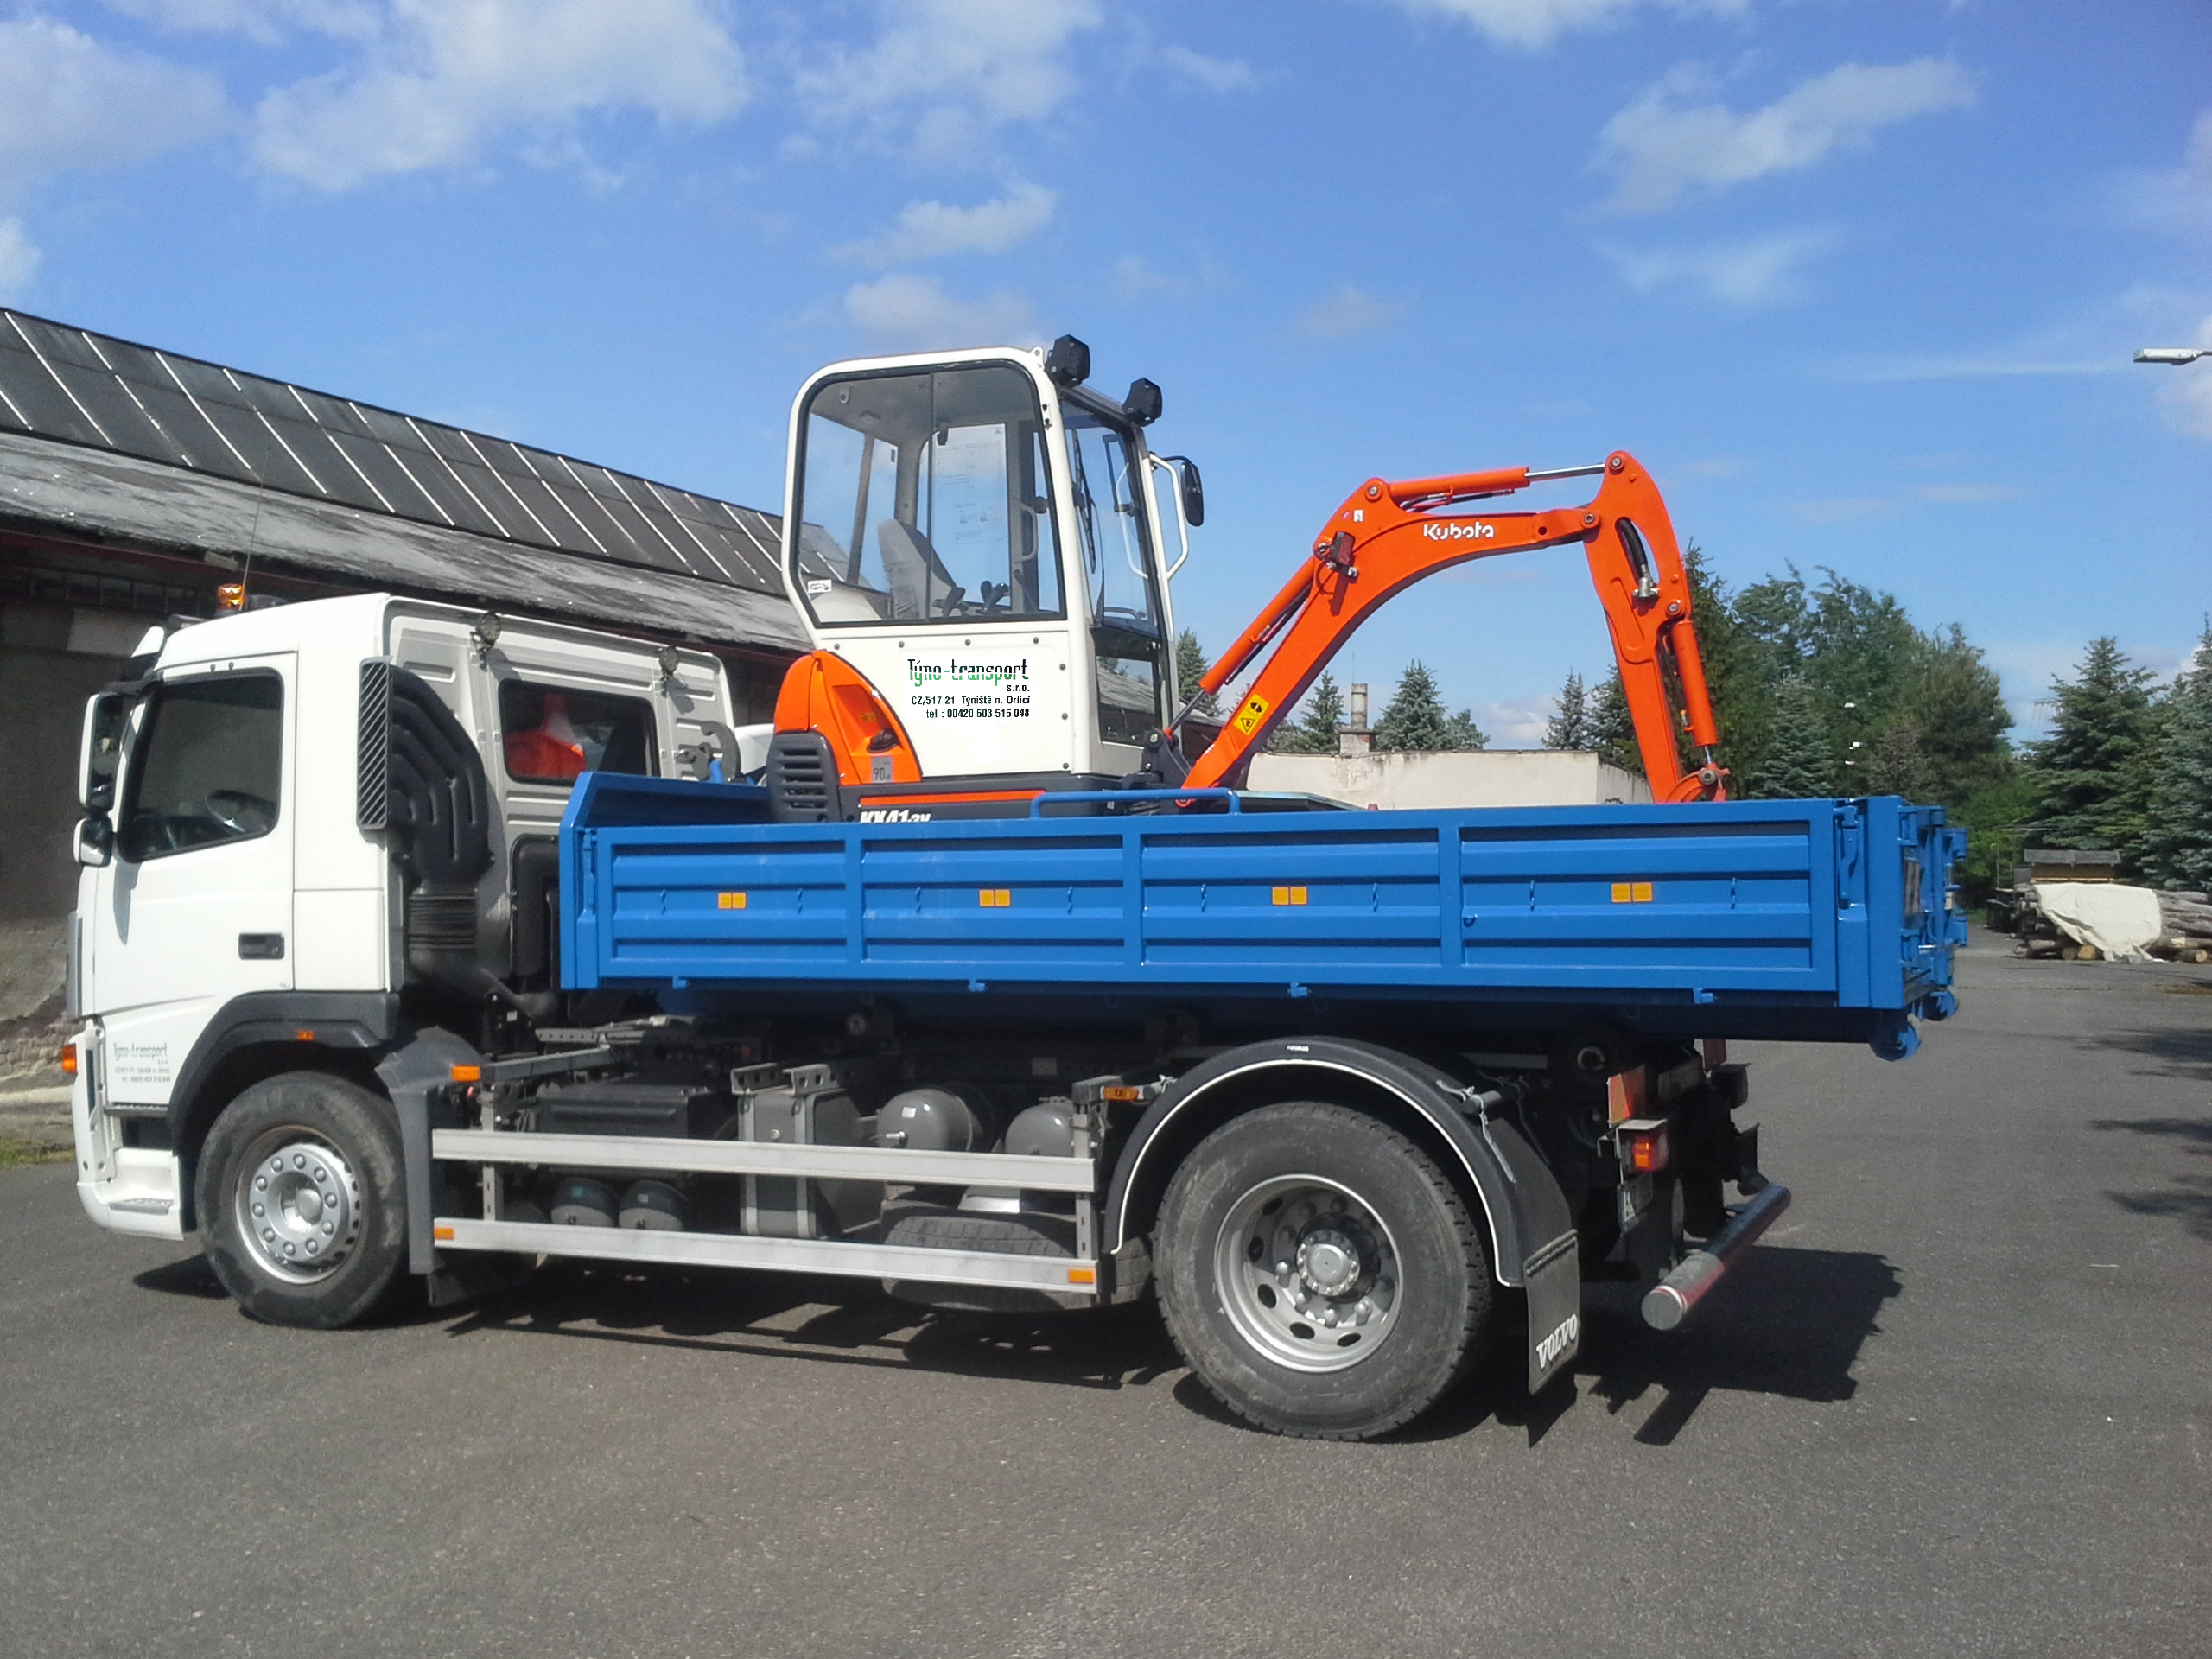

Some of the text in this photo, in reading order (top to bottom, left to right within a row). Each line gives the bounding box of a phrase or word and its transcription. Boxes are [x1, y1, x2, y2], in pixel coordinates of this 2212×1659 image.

[1423, 521, 1494, 540] Kubota
[912, 696, 942, 706] CZ/517
[944, 696, 955, 705] 21
[962, 696, 992, 707] Týniště
[947, 709, 974, 718] 00420
[976, 709, 993, 718] 603
[995, 709, 1012, 718] 516
[1014, 708, 1030, 718] 048
[1536, 1313, 1578, 1369] VOLVO
